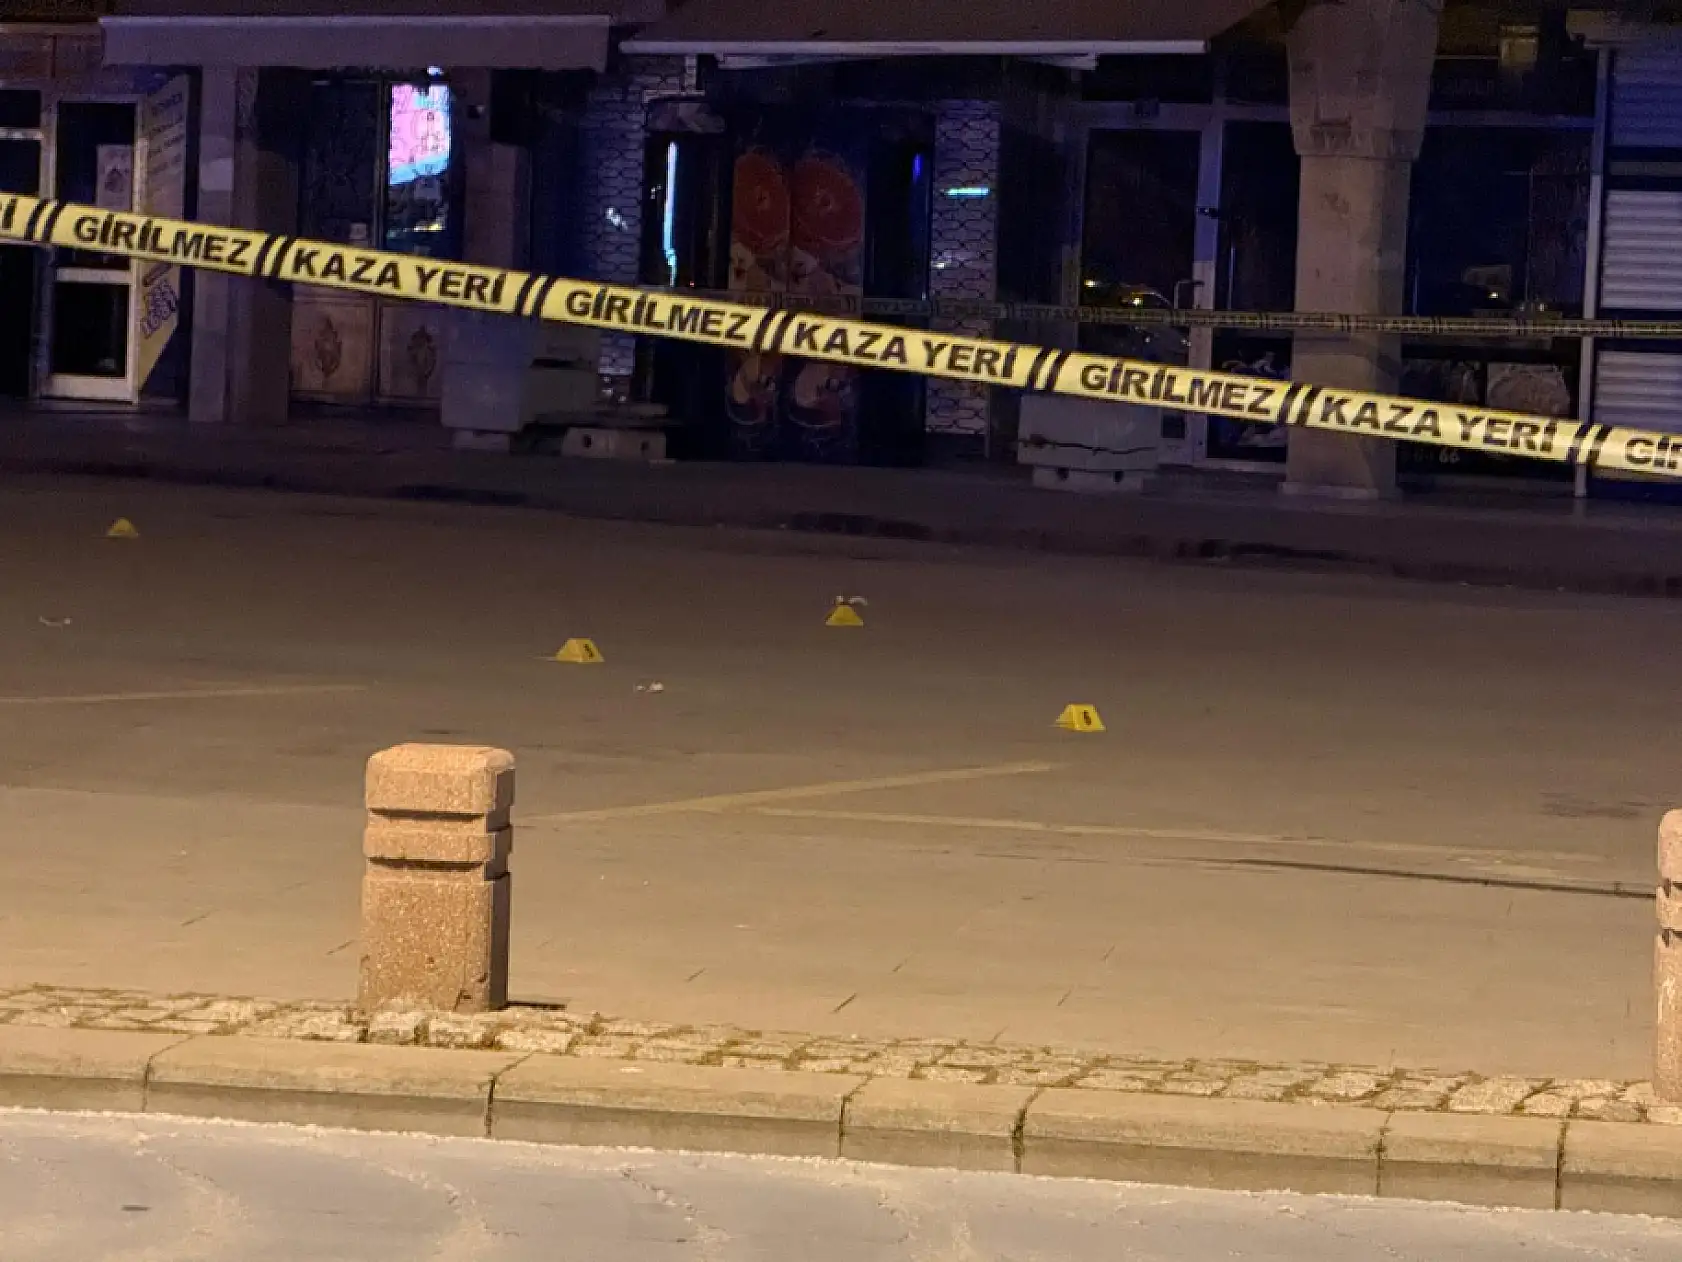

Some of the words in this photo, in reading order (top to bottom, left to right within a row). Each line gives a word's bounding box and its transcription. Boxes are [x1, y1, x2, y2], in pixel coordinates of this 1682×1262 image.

[74, 212, 252, 266] GİRİLMEZ
[293, 248, 400, 290] KAZA
[415, 265, 507, 304] YERİ
[565, 285, 752, 340] GİRİLMEZ
[794, 320, 908, 364] KAZA
[922, 340, 1019, 379] YERİ
[1081, 359, 1275, 415] GİRİLMEZ
[1320, 395, 1442, 437] KAZA
[1456, 414, 1558, 452] YERİ
